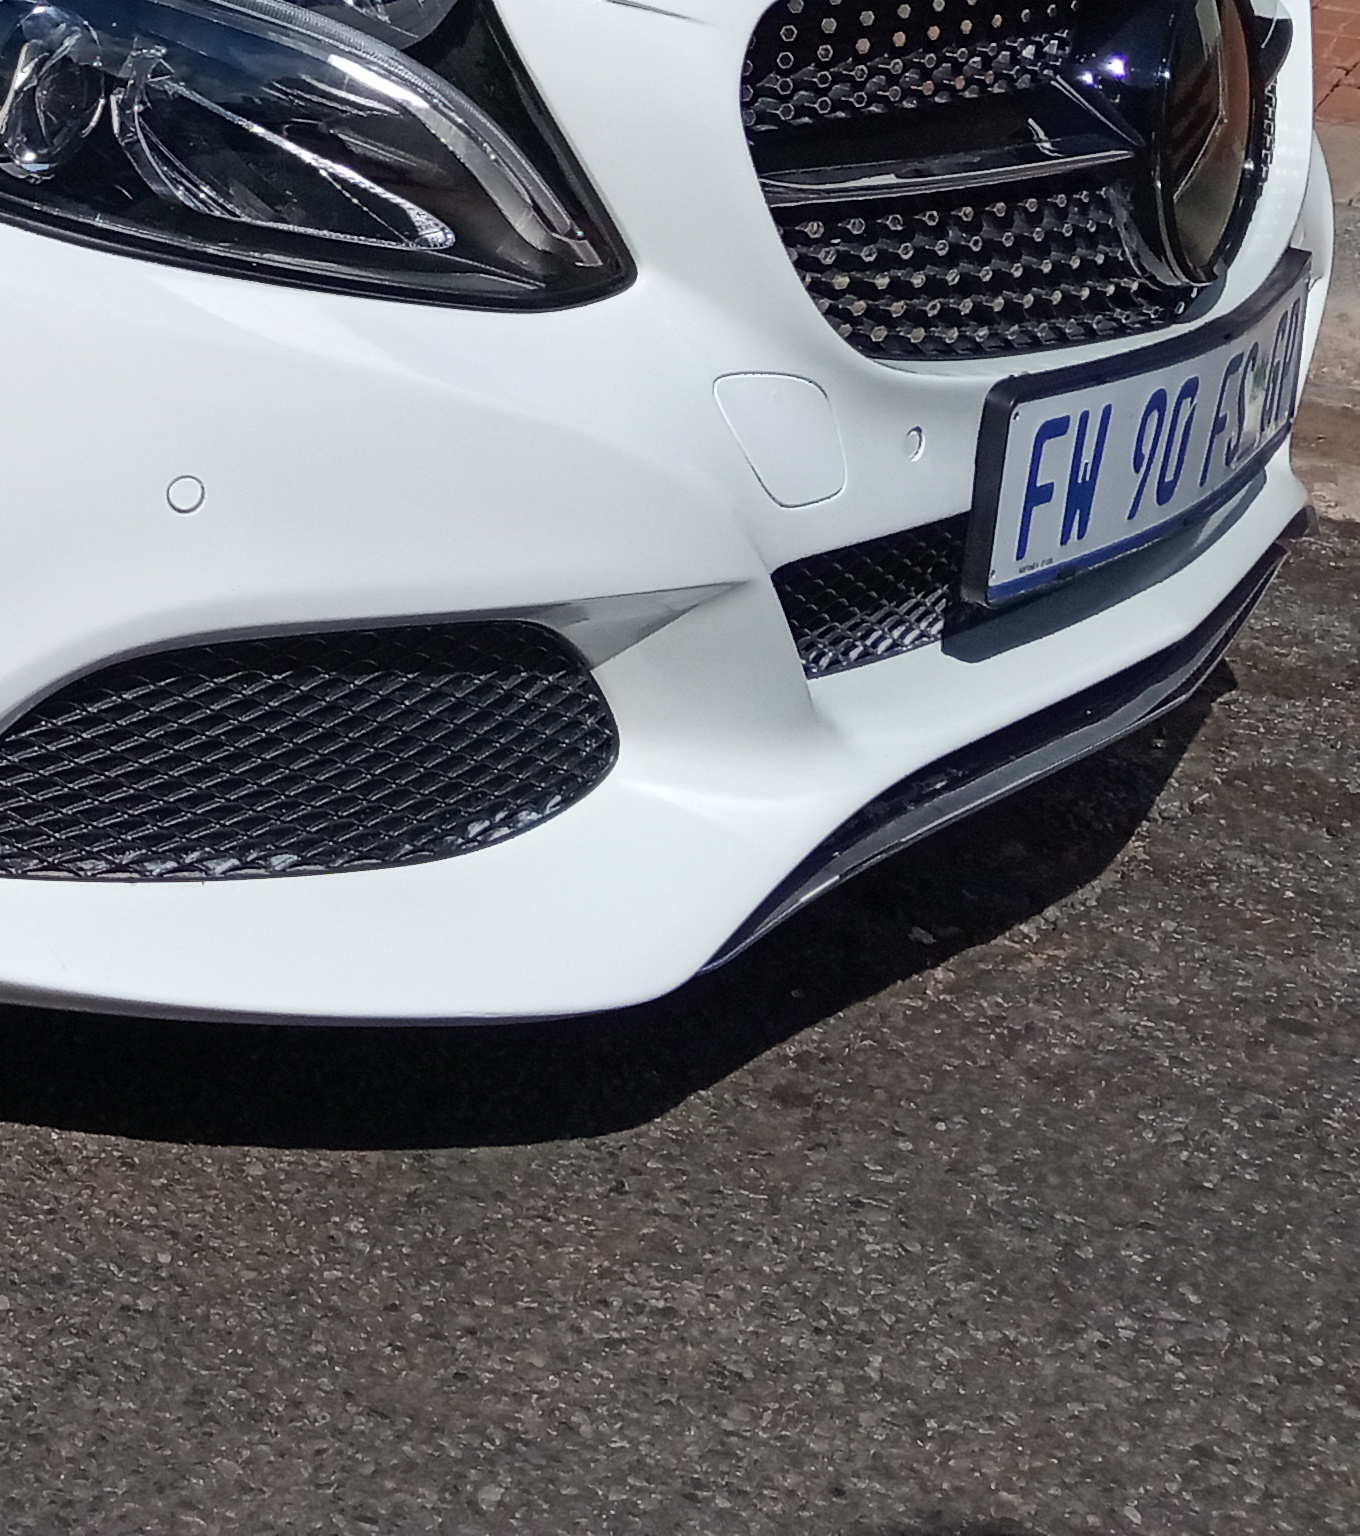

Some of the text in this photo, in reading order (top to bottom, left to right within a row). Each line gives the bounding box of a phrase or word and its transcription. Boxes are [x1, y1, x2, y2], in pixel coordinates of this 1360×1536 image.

[1015, 404, 1112, 561] FW
[1127, 376, 1199, 520] 90
[1199, 341, 1259, 487] FS
